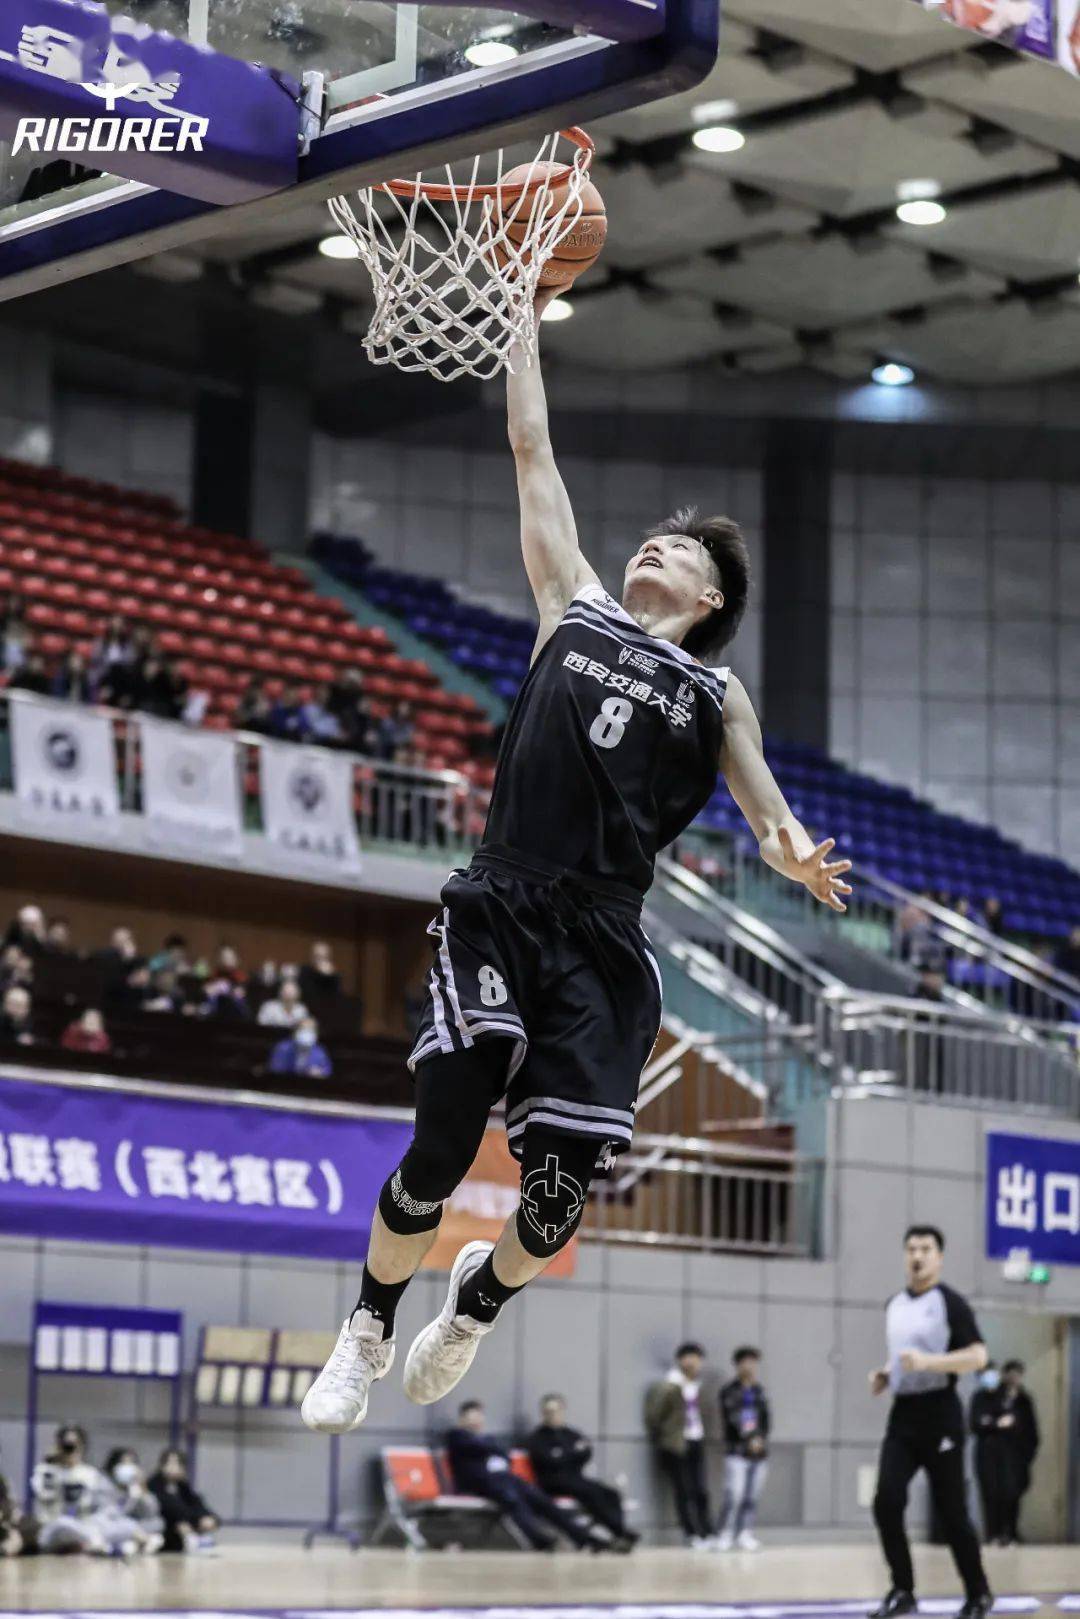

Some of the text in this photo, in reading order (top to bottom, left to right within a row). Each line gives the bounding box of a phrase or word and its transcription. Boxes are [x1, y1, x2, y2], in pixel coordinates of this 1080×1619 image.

[563, 651, 693, 728] 西安交通大学
[589, 696, 634, 749] 8
[477, 965, 508, 1006] 8
[0, 1132, 343, 1215] 联赛（西北赛区）
[996, 1163, 1080, 1235] 出口
